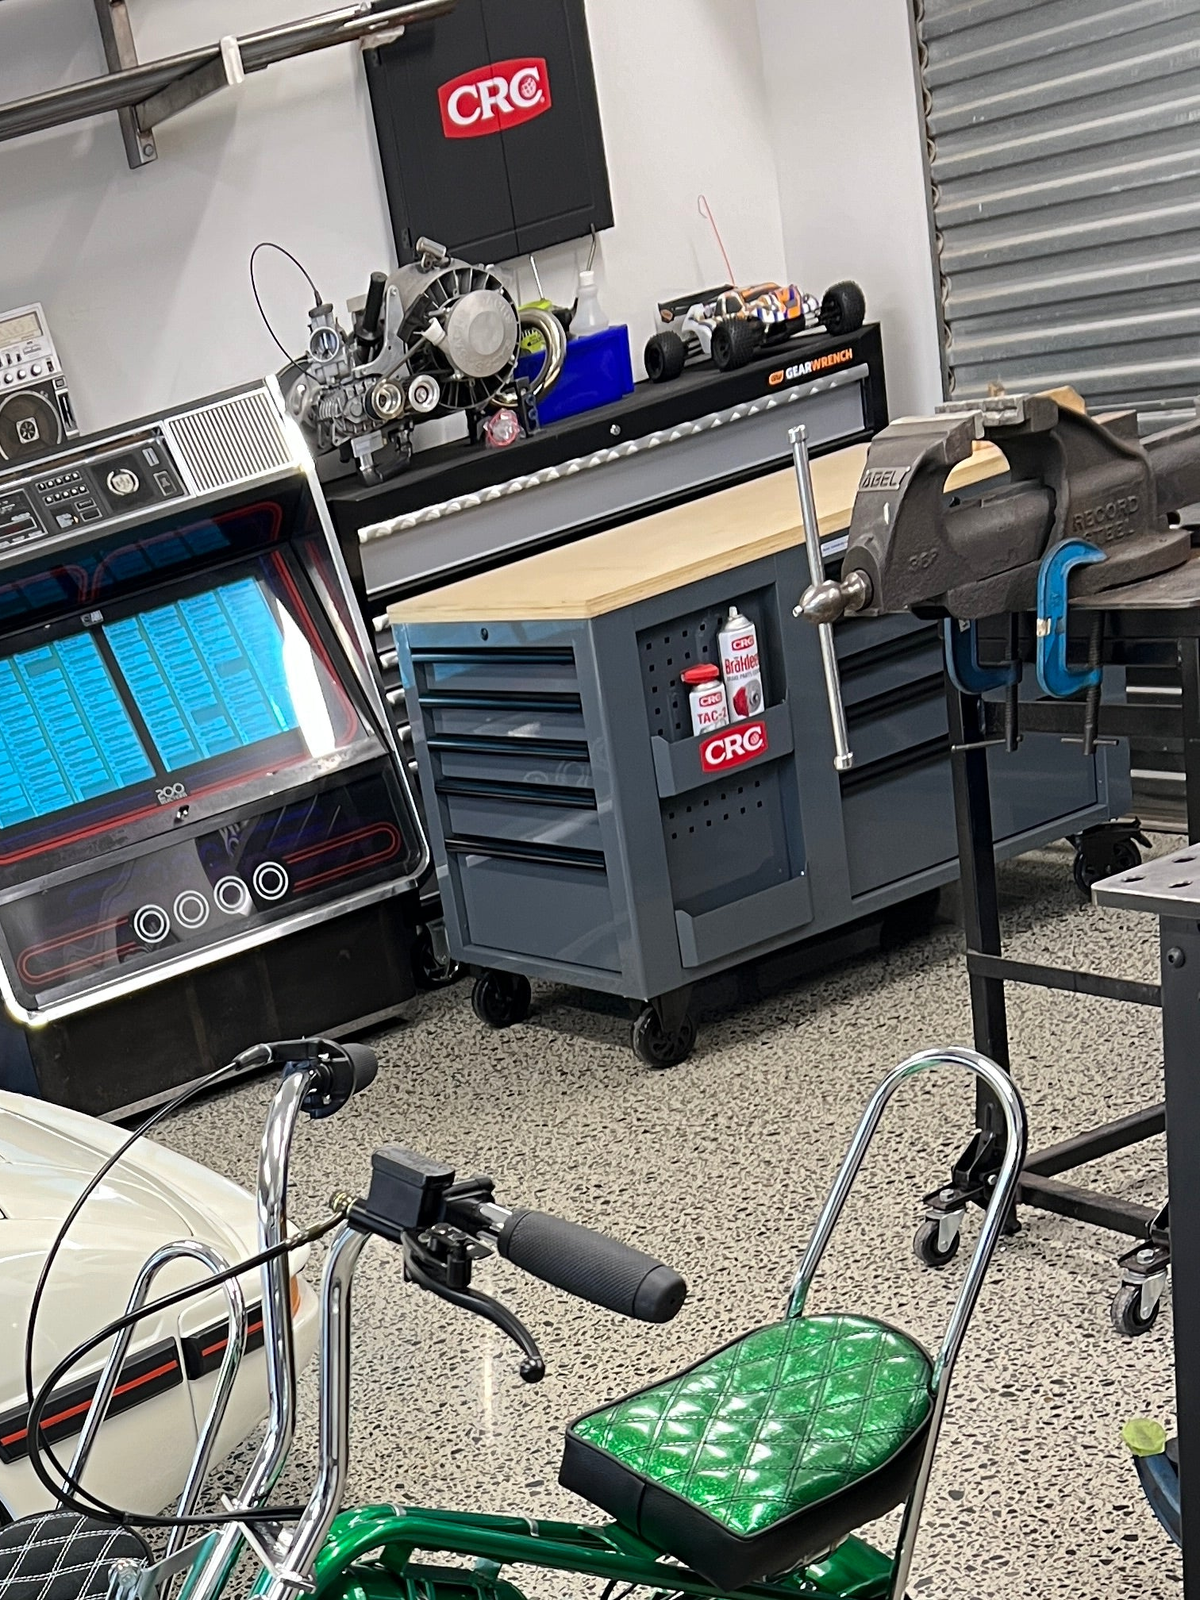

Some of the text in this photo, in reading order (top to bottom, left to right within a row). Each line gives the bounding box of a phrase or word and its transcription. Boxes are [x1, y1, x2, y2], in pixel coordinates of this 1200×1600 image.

[447, 66, 543, 126] CRC
[785, 348, 853, 379] GEARWRENCH
[862, 470, 898, 488] ABEL
[1073, 495, 1139, 532] RECORD
[733, 635, 755, 650] CRC
[700, 692, 722, 707] CRC
[705, 725, 763, 764] CRC
[155, 783, 186, 802] 200
